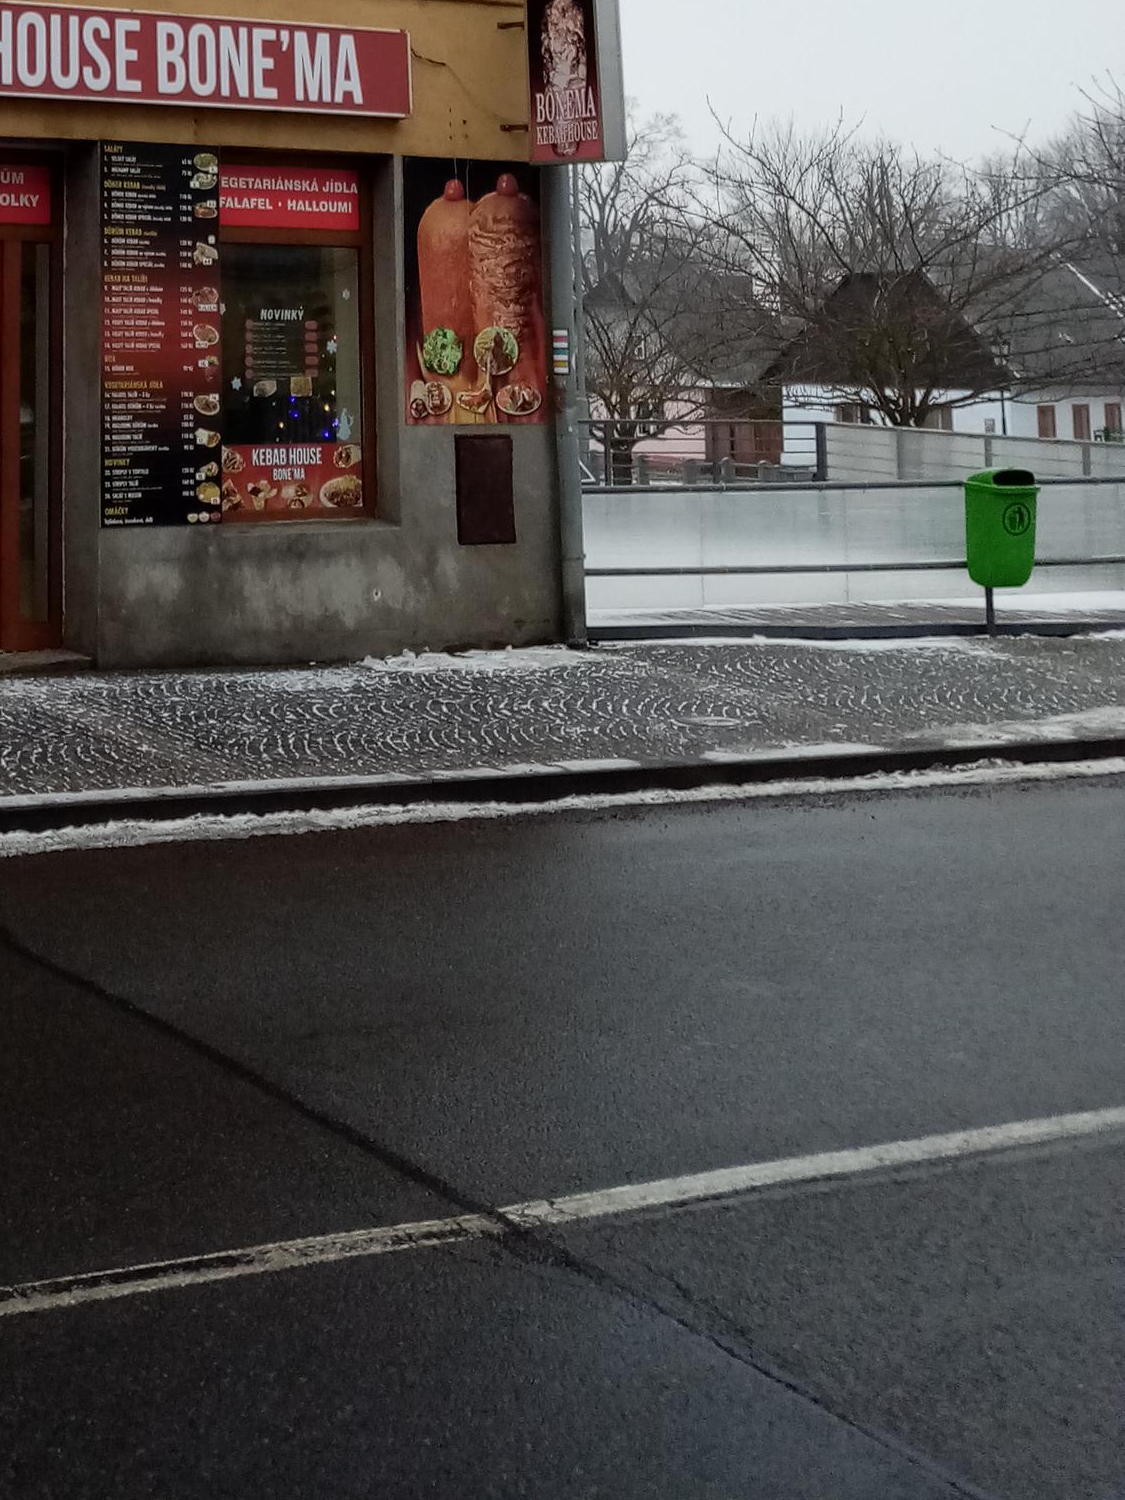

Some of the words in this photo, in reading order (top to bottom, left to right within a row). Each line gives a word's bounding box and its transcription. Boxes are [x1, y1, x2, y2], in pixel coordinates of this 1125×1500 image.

[157, 17, 364, 105] BONE'MA
[537, 124, 567, 145] KEBAB
[567, 120, 598, 142] HOUSE
[322, 178, 358, 194] JÍDLA
[219, 196, 273, 210] FALAFEL
[287, 199, 352, 213] HALLOUMI
[251, 448, 287, 467] KEBAB
[289, 447, 323, 466] HOUSE
[273, 467, 305, 481] BONE'MA
